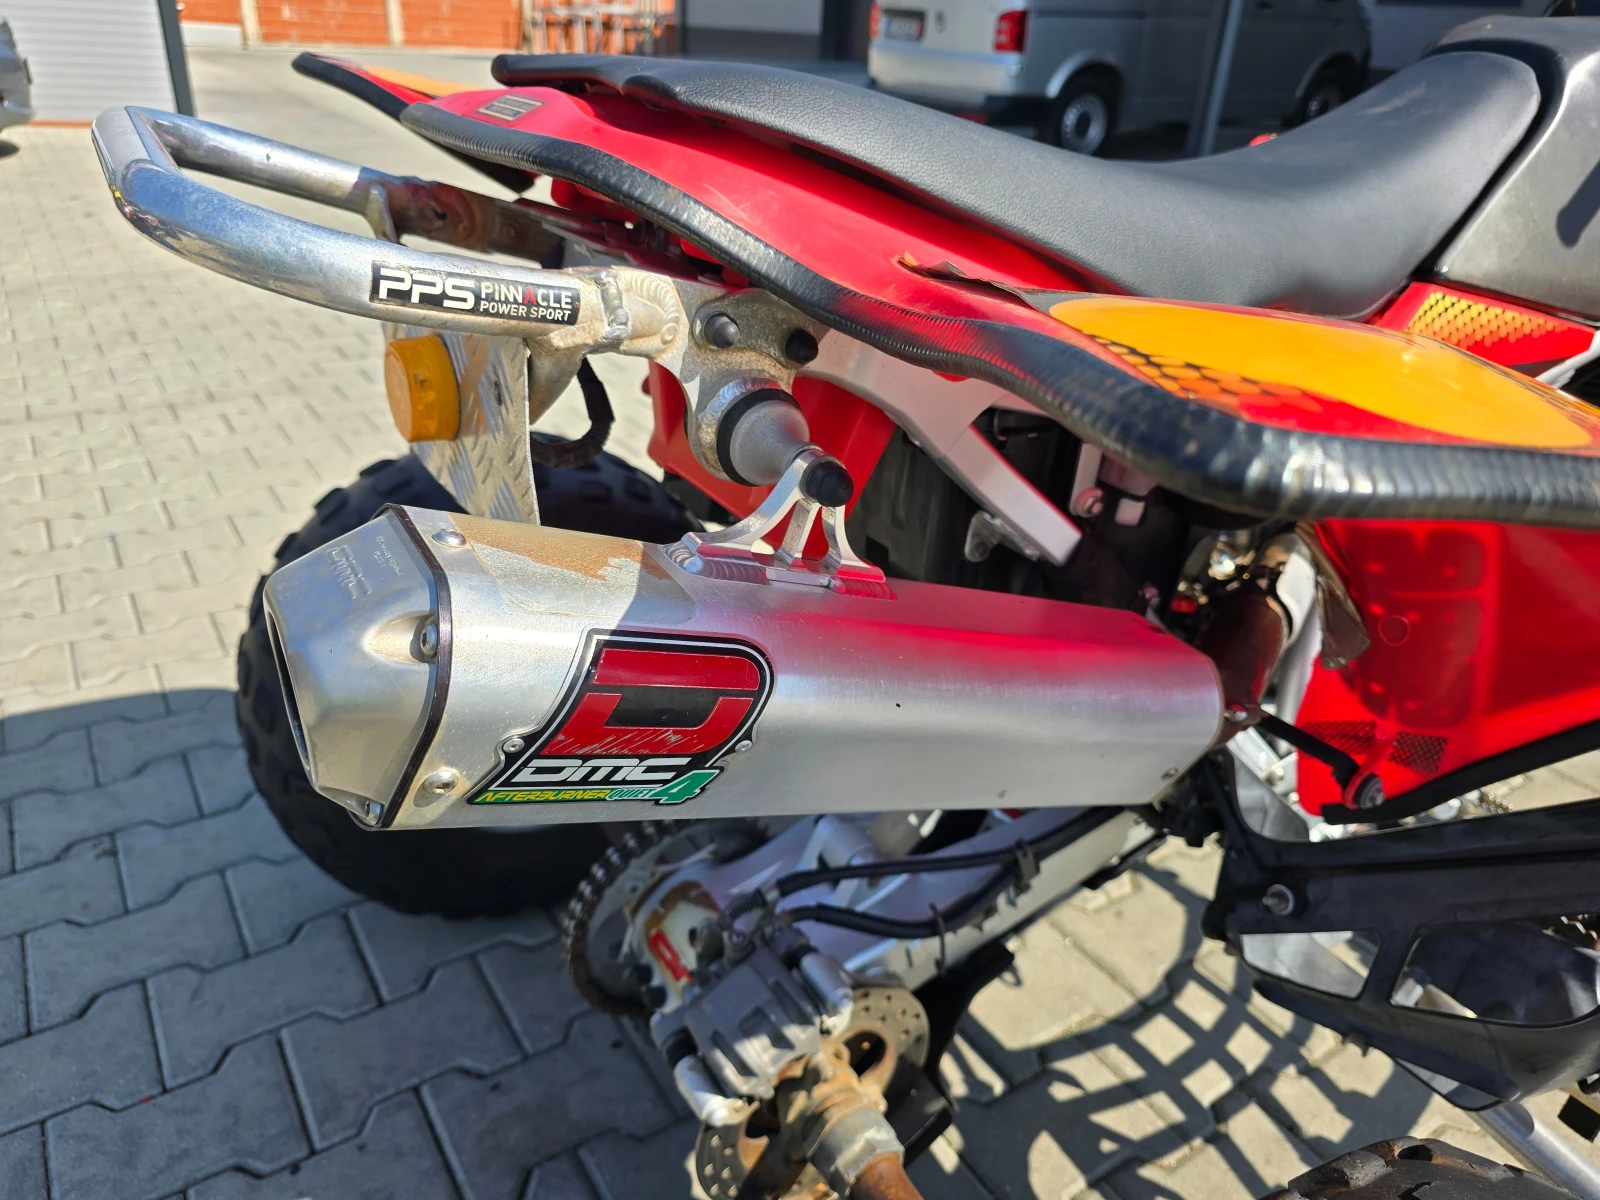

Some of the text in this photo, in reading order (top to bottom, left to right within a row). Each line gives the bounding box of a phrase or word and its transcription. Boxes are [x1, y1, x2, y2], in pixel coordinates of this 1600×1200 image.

[378, 268, 476, 310] PPS
[480, 281, 572, 309] PINNACLE
[479, 301, 571, 321] POWER SPORT
[510, 757, 692, 783] DMC
[476, 769, 720, 804] AFTERBURNER QUIET 4
